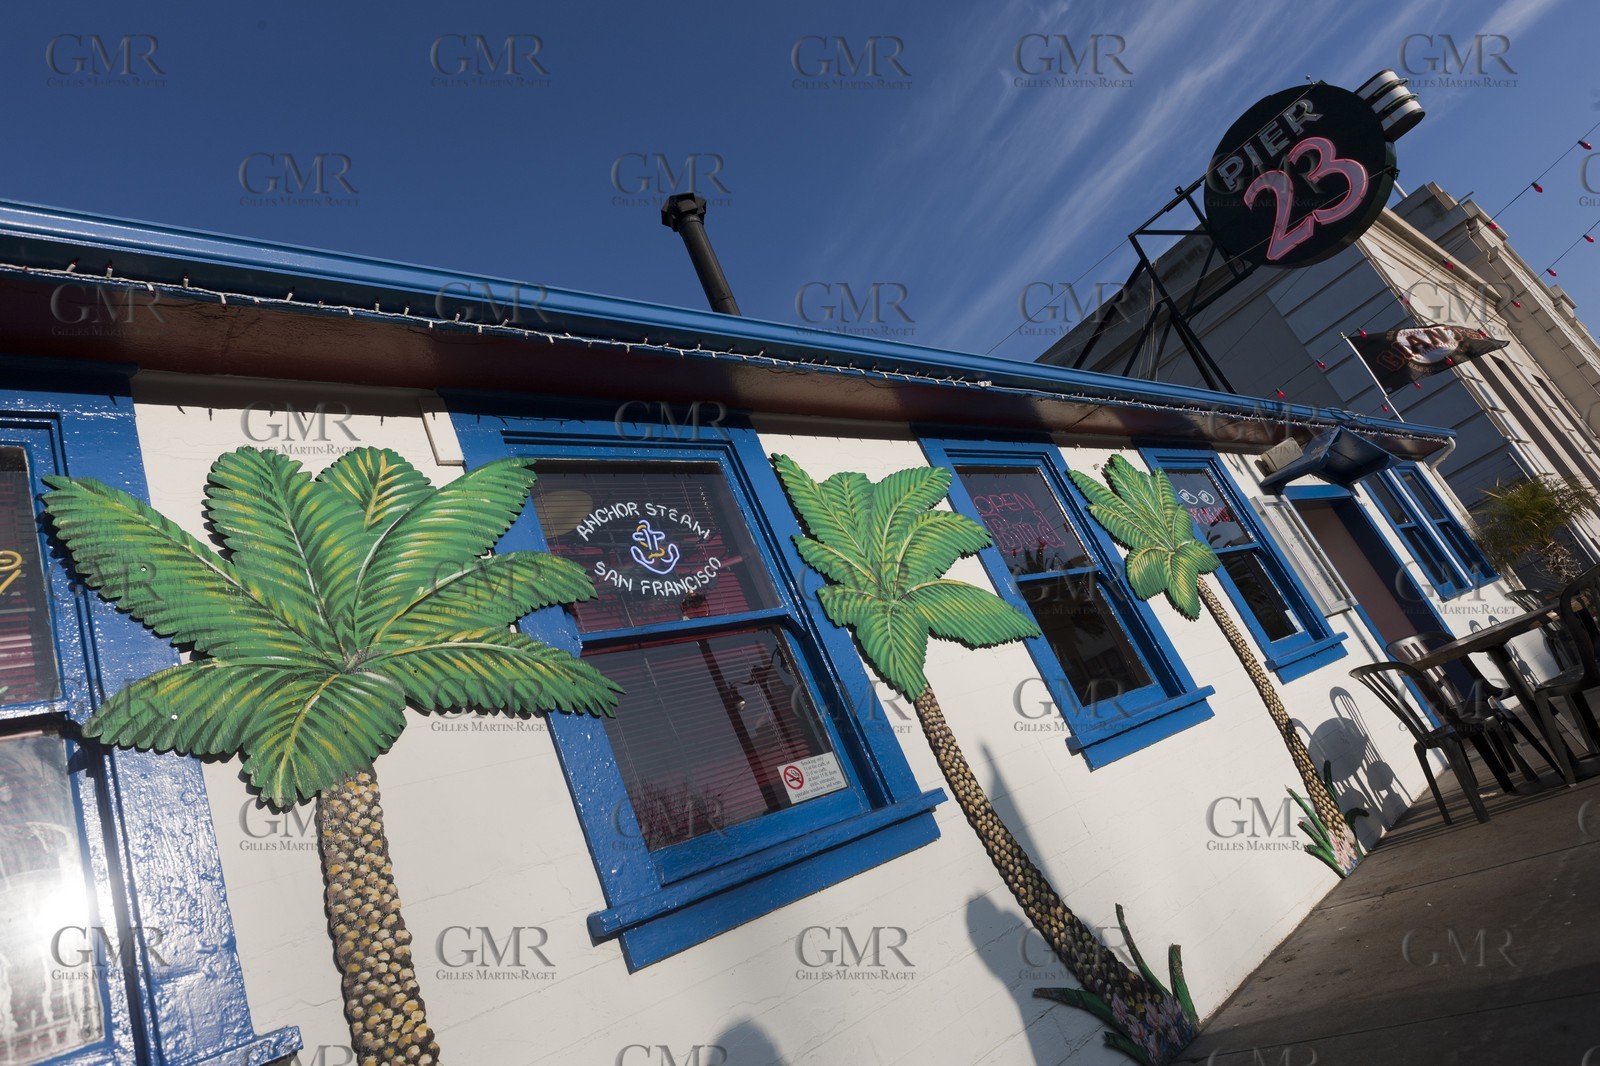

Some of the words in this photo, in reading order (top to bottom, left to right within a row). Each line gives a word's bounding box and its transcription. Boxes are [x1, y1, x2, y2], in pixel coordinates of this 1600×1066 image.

[1217, 99, 1324, 191] PIER
[1243, 136, 1369, 261] 23
[576, 502, 640, 541] ANCHOR
[645, 503, 710, 539] STEAM
[973, 492, 1036, 514] OPEN
[594, 561, 633, 592] SAN
[641, 557, 722, 597] FRANCISCO
